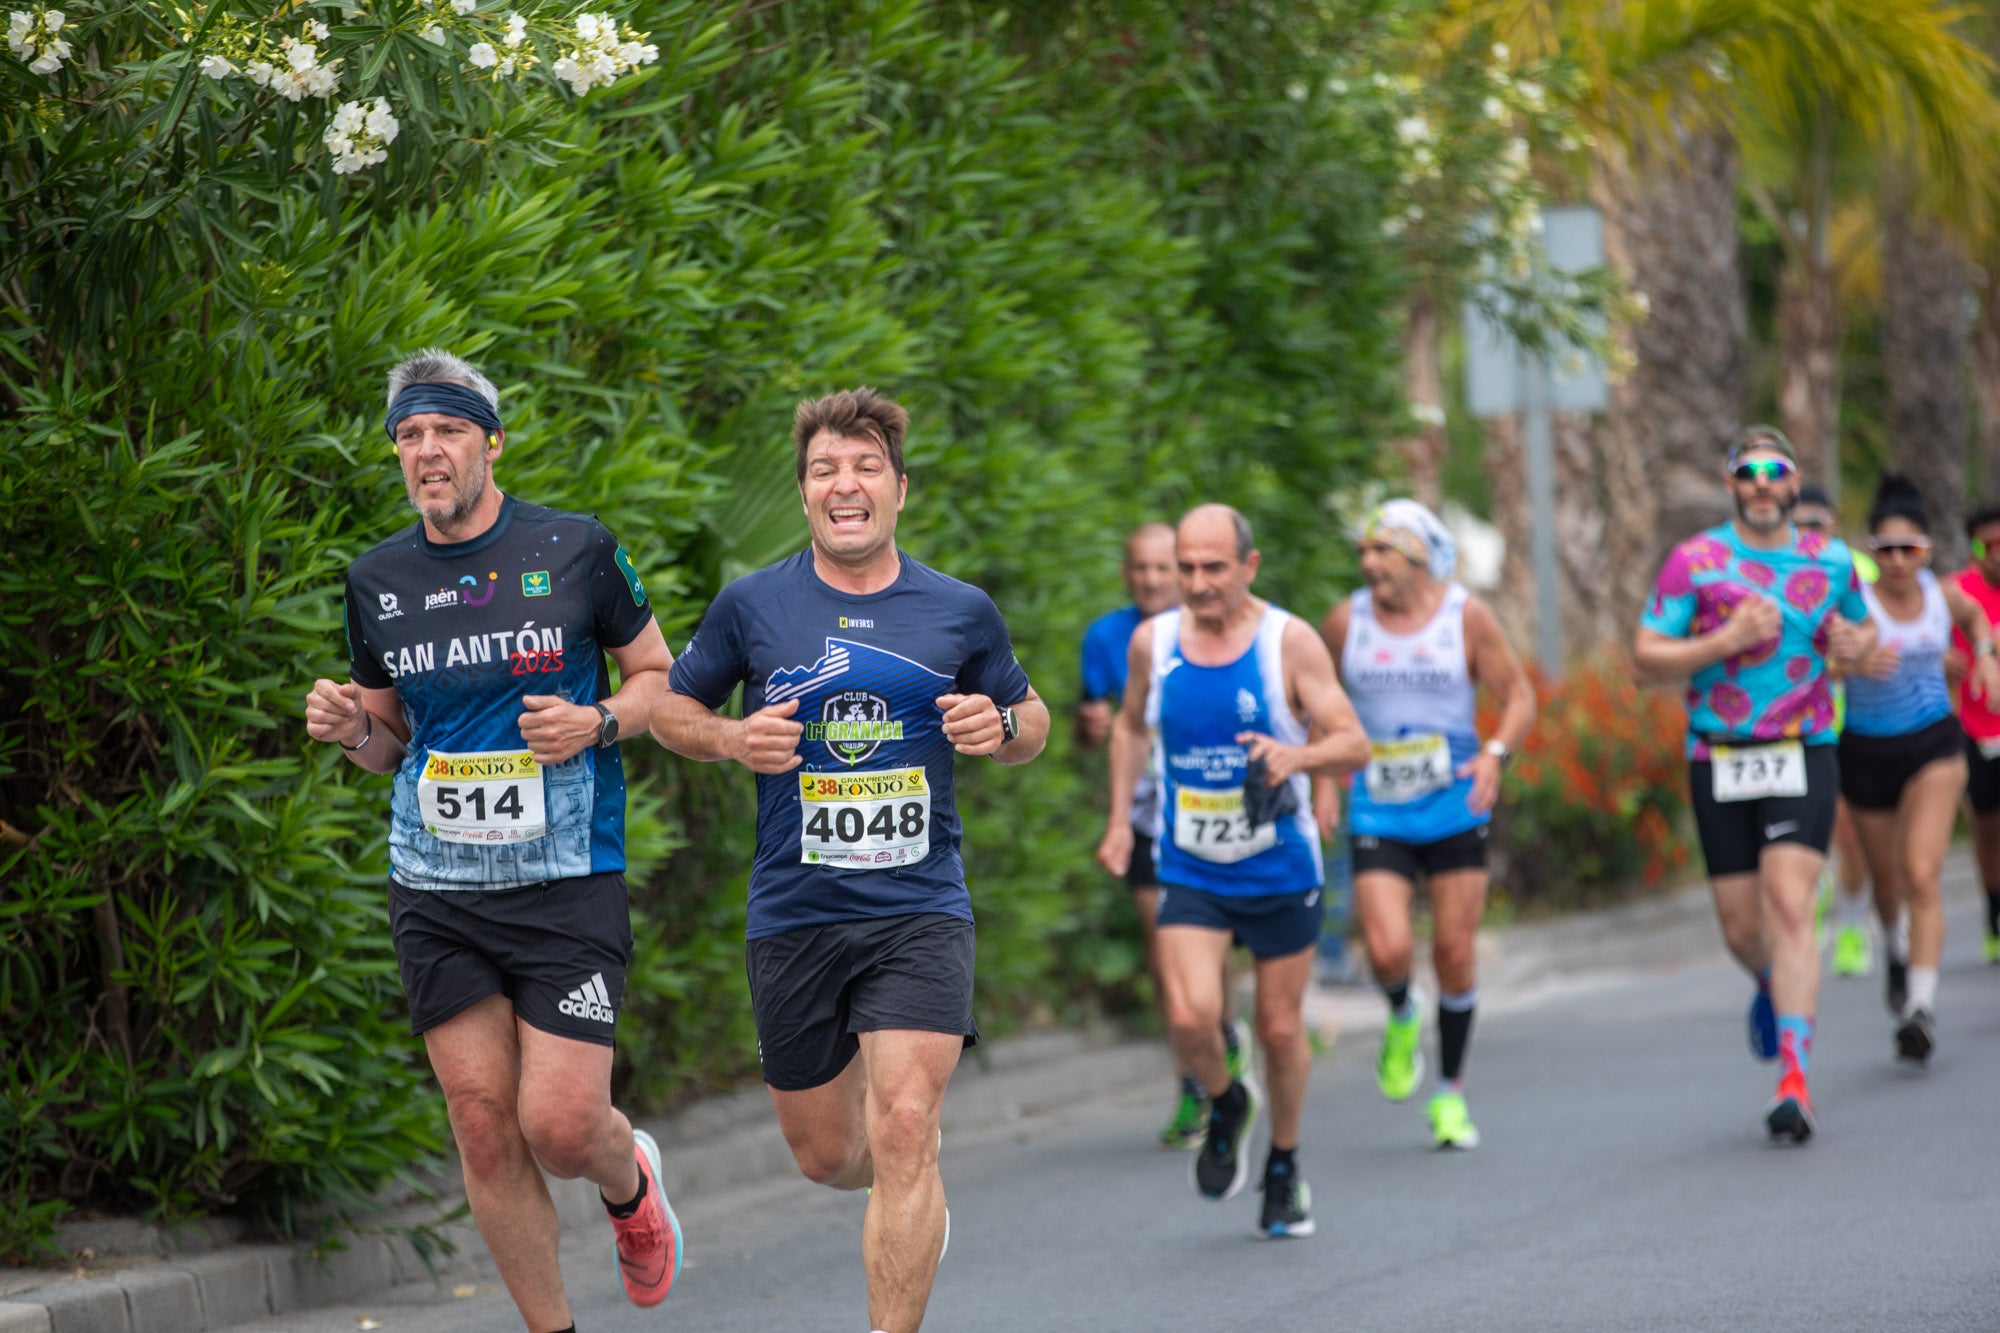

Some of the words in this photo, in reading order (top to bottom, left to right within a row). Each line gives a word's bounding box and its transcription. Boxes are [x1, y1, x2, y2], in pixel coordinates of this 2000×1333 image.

[384, 641, 435, 680] SAN
[446, 621, 563, 668] ANTÓN
[510, 649, 565, 676] 2025
[843, 691, 868, 702] CLUB
[866, 774, 897, 783] PREMIO
[1730, 756, 1787, 785] 737
[817, 778, 837, 795] 38
[838, 781, 903, 796] FONDO
[436, 785, 524, 821] 514
[805, 802, 925, 843] 4048
[1190, 816, 1257, 844] 723
[558, 998, 614, 1024] adidas
